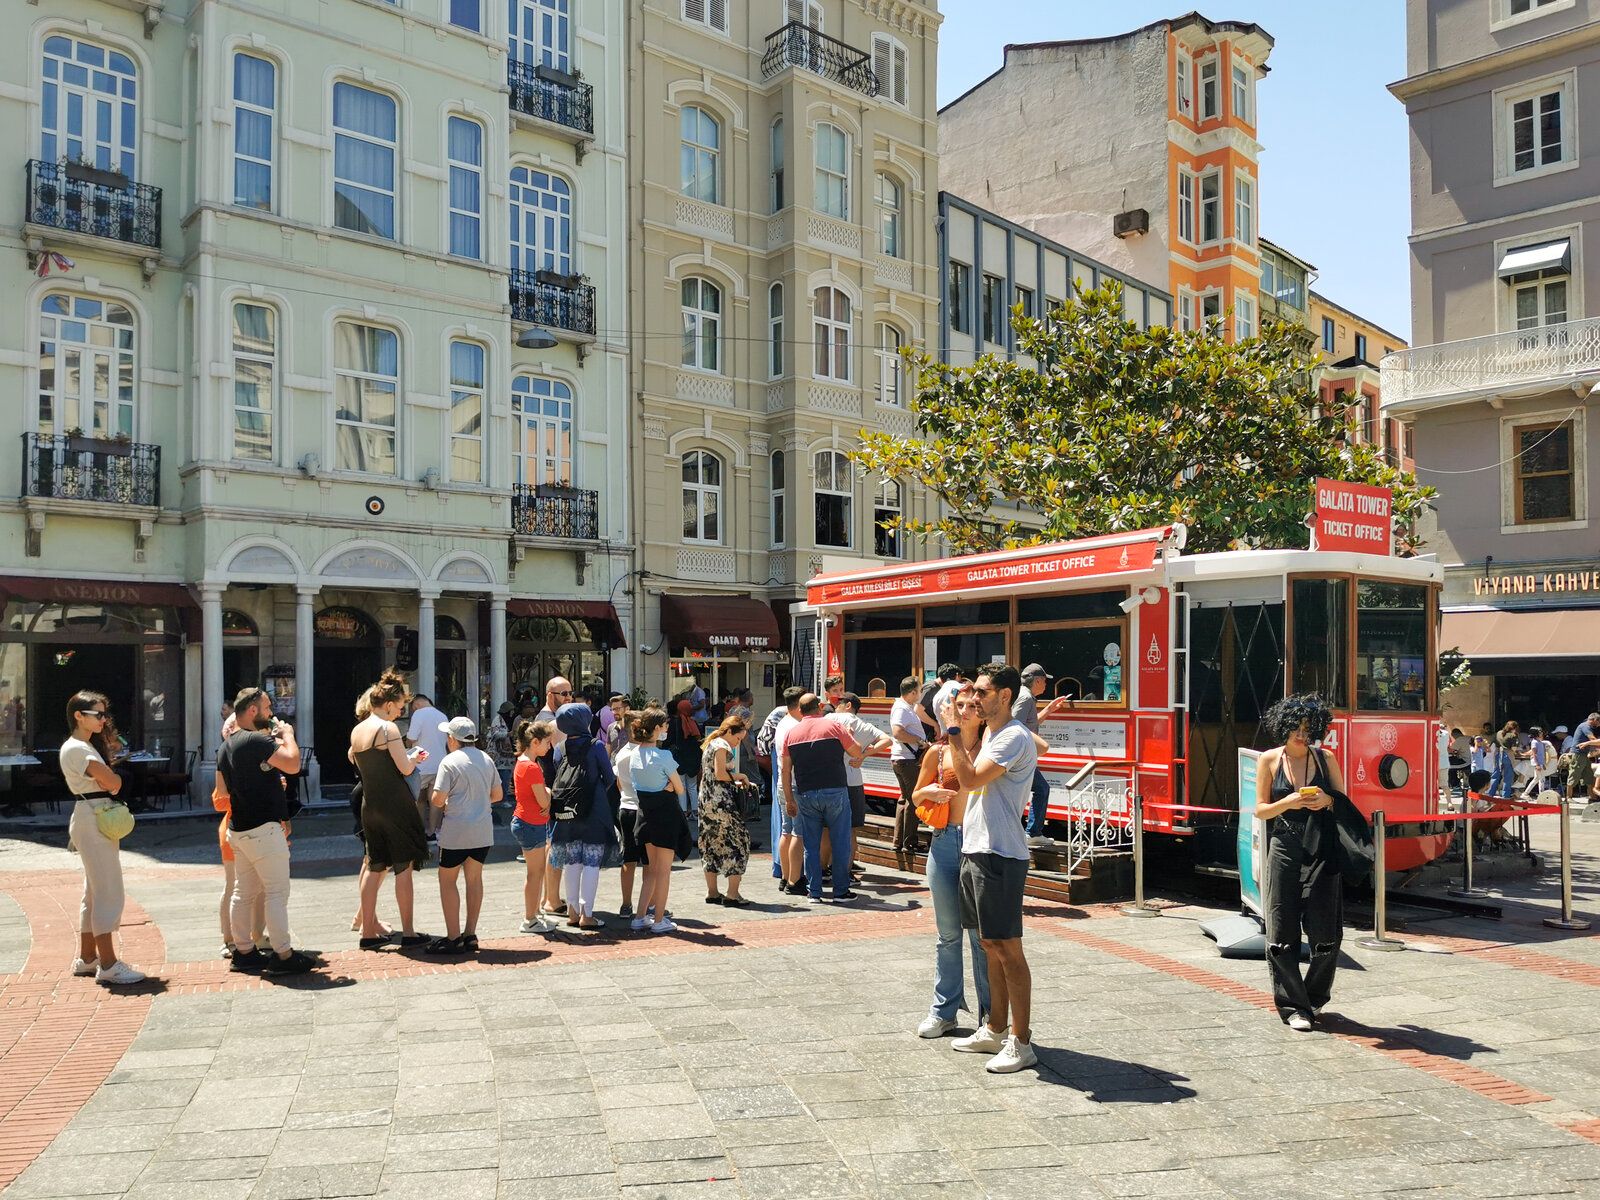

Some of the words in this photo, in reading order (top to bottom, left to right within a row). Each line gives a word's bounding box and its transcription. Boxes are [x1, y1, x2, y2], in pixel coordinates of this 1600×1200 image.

[1319, 488, 1355, 513] GALATA
[1356, 494, 1389, 517] TOWER
[1323, 519, 1353, 538] TICKET
[1354, 523, 1384, 542] OFFICE
[967, 567, 998, 582] GALATA
[998, 563, 1029, 577] TOWER
[1030, 559, 1060, 574] TICKET
[1062, 555, 1096, 570] OFFICE
[840, 584, 864, 597] GALATA
[1543, 571, 1600, 593] KAHVE
[52, 584, 140, 600] ANEMON
[527, 602, 586, 614] ANEMON
[708, 635, 740, 646] GALATA
